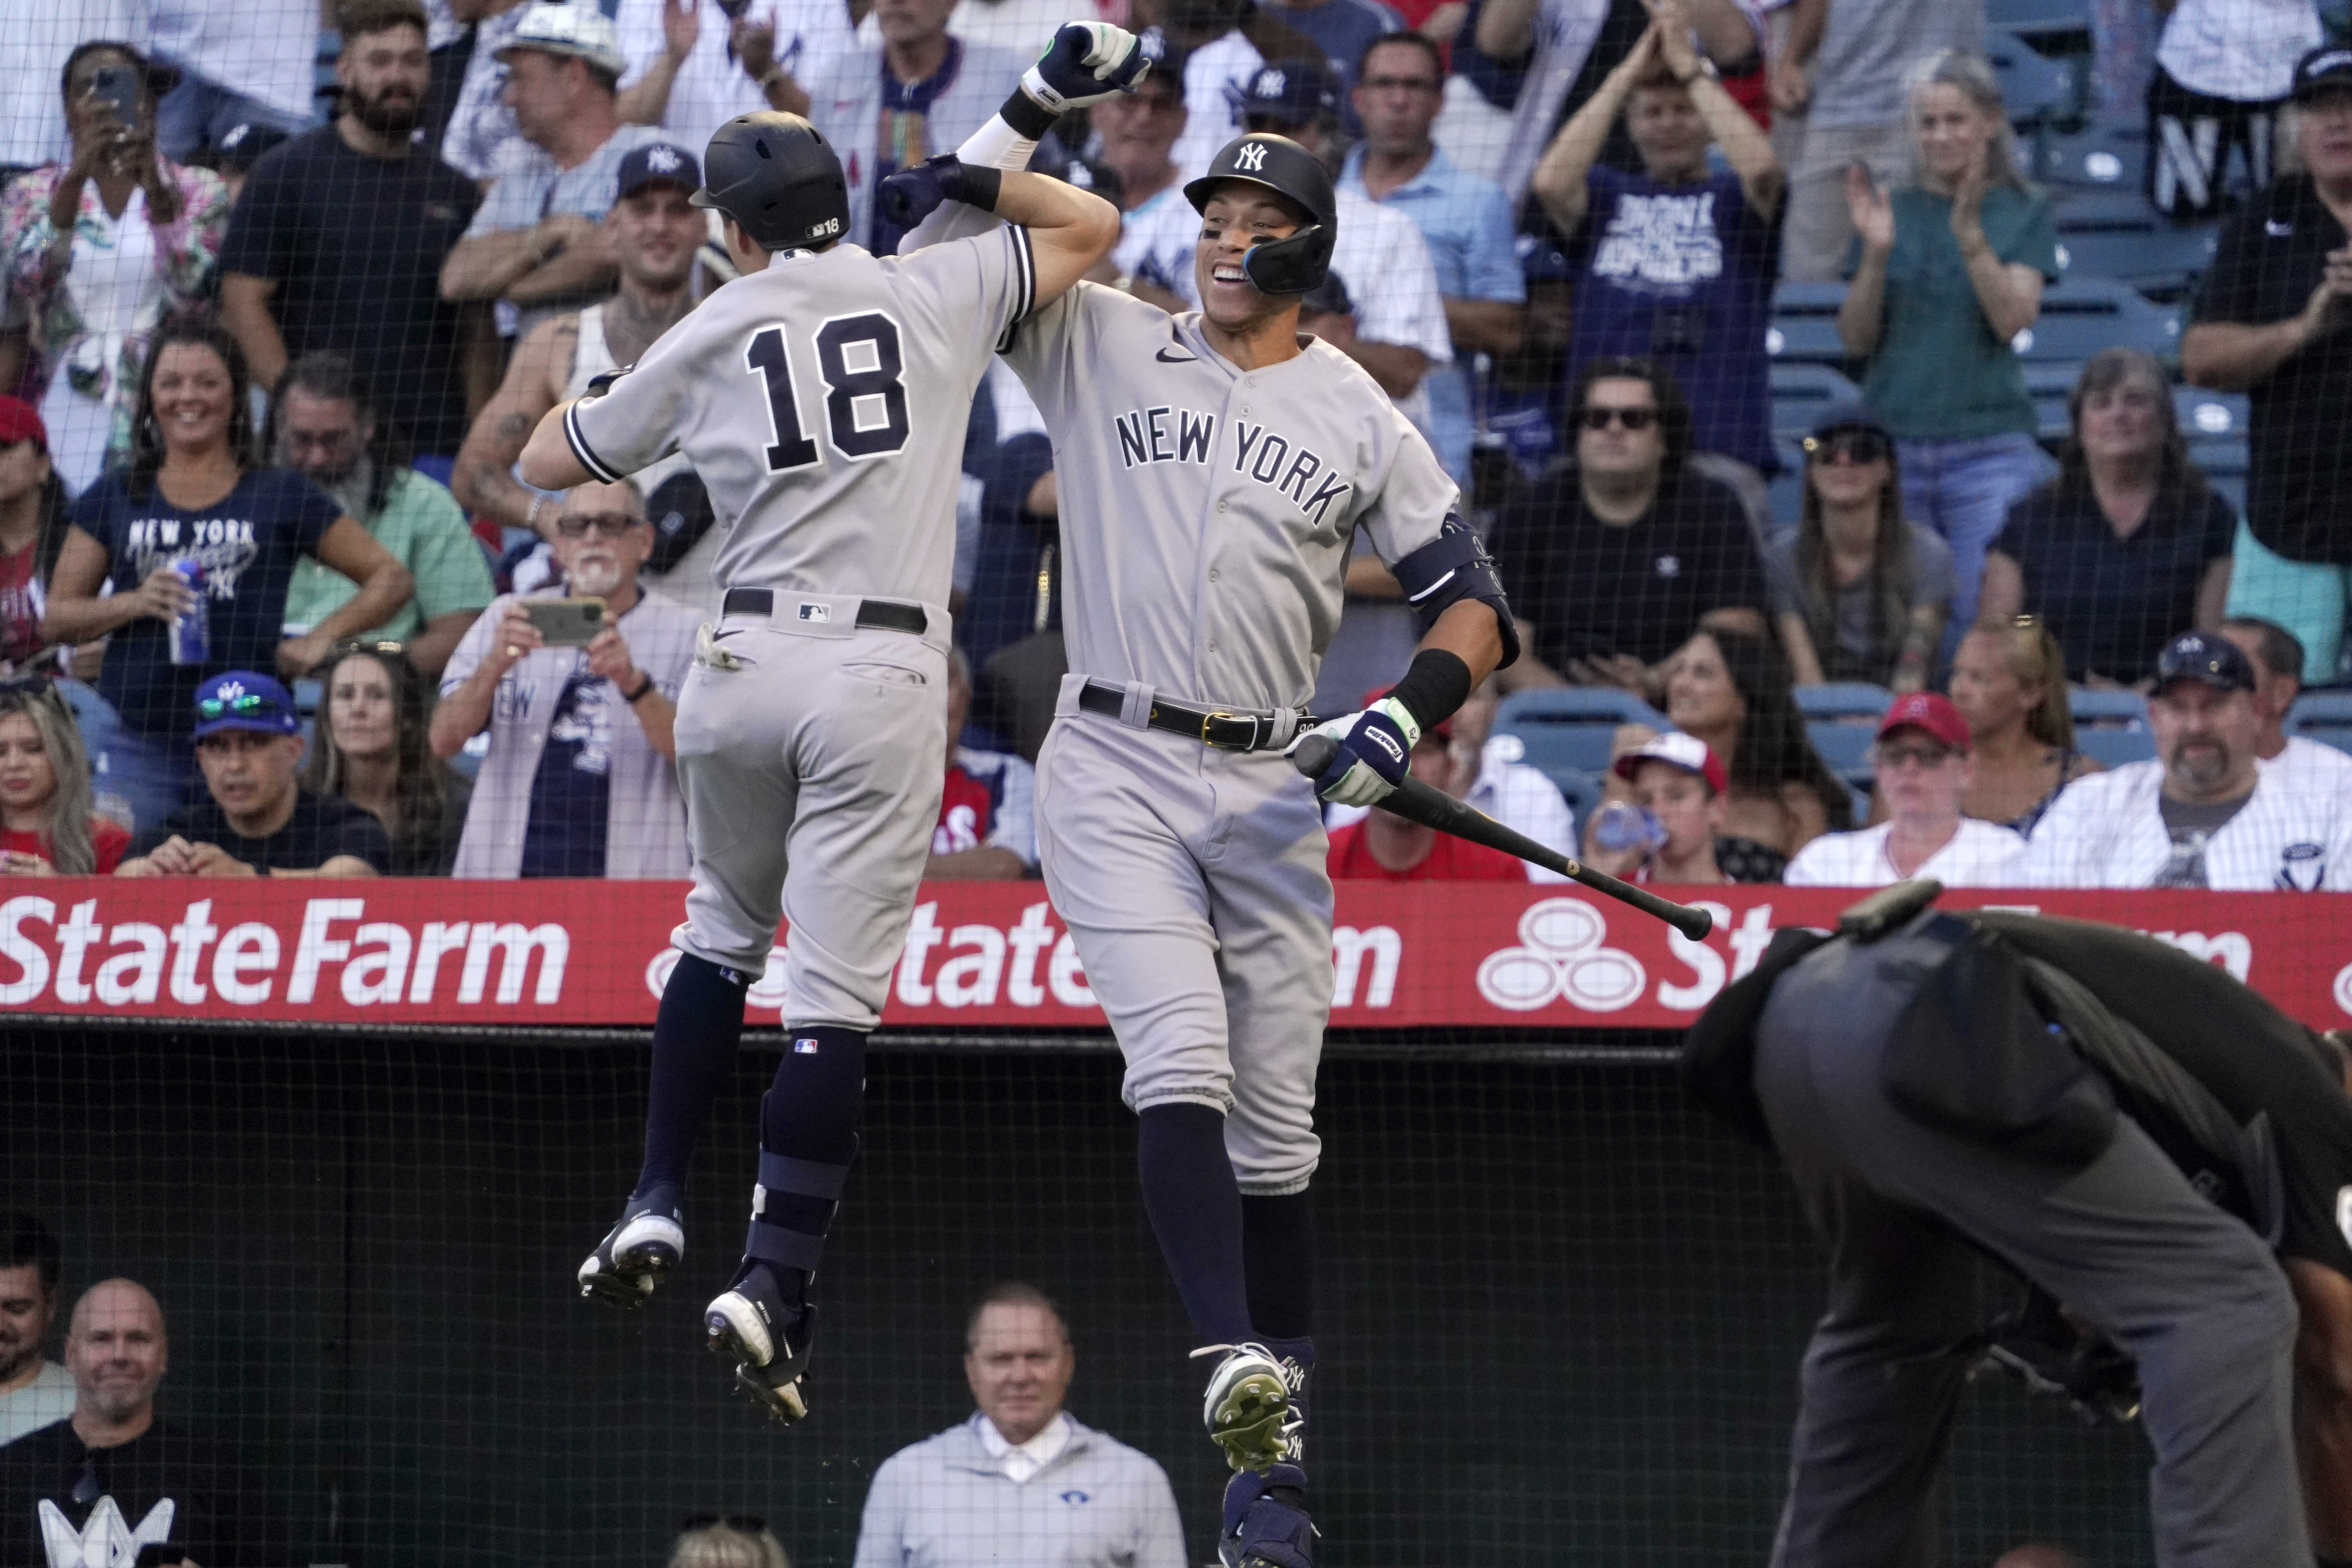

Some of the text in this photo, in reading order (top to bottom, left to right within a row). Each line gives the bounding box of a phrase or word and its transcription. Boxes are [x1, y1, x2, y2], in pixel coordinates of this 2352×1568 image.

[1234, 142, 1268, 172] NY
[824, 217, 839, 234] 18
[744, 308, 913, 476] 18
[1114, 405, 1352, 529] NEW YORK
[128, 518, 254, 546] NEW YORK
[1367, 728, 1404, 758] Franklin
